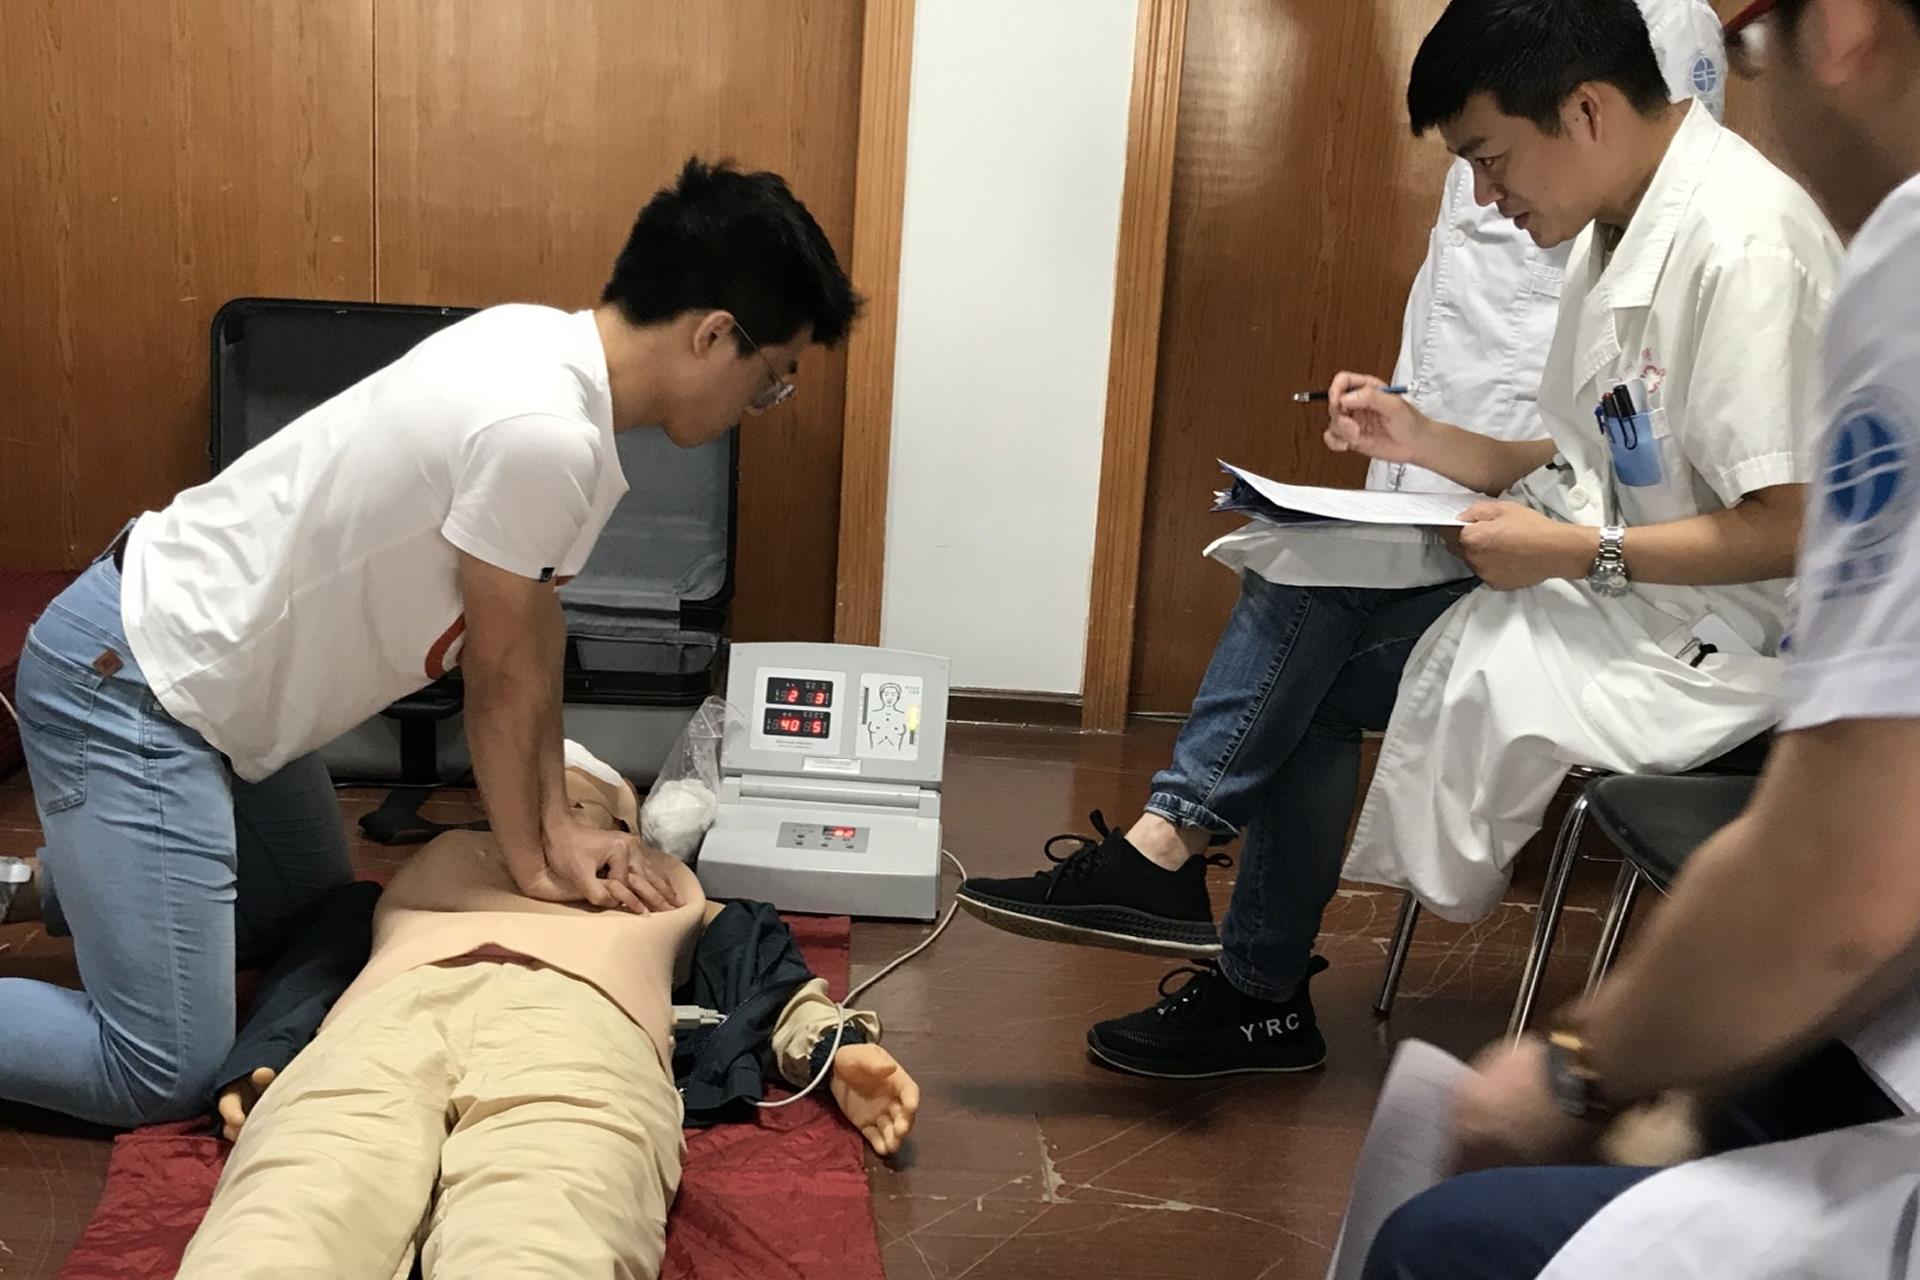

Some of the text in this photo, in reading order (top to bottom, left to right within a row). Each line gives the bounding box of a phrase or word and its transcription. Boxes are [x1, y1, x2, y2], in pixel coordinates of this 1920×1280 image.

[787, 689, 799, 703] 2
[814, 692, 825, 705] 3
[780, 719, 800, 732] 40
[811, 720, 822, 733] 5
[1240, 1013, 1300, 1042] Y'RC
